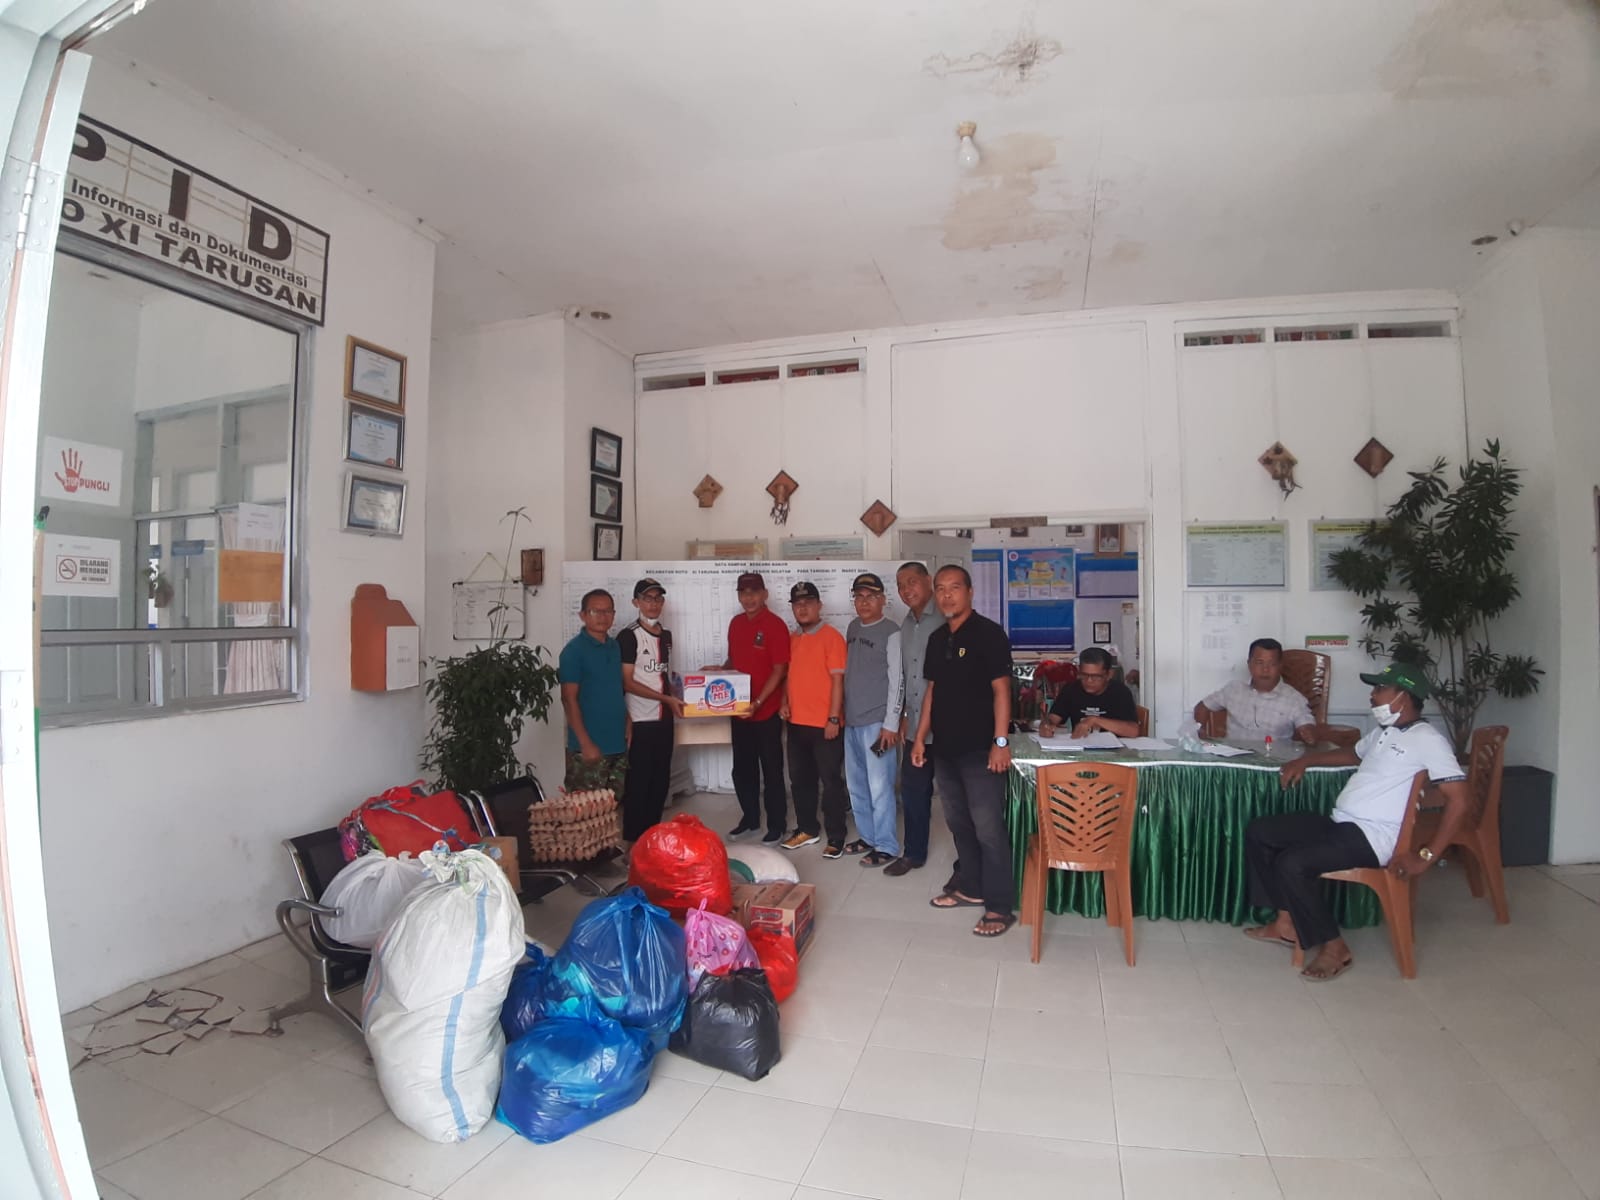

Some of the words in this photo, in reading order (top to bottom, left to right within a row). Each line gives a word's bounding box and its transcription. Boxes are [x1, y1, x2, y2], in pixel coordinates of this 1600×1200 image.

[168, 168, 190, 221] I
[248, 205, 292, 261] D
[71, 178, 163, 228] Informasi
[169, 223, 201, 244] dan
[207, 234, 308, 289] Dokumentasi
[98, 211, 140, 245] XI
[154, 232, 317, 314] TARUSAN
[79, 478, 110, 492] PUNGLI
[79, 559, 109, 567] DILARANG
[79, 567, 109, 575] MEROKOK
[643, 658, 669, 673] Jee
